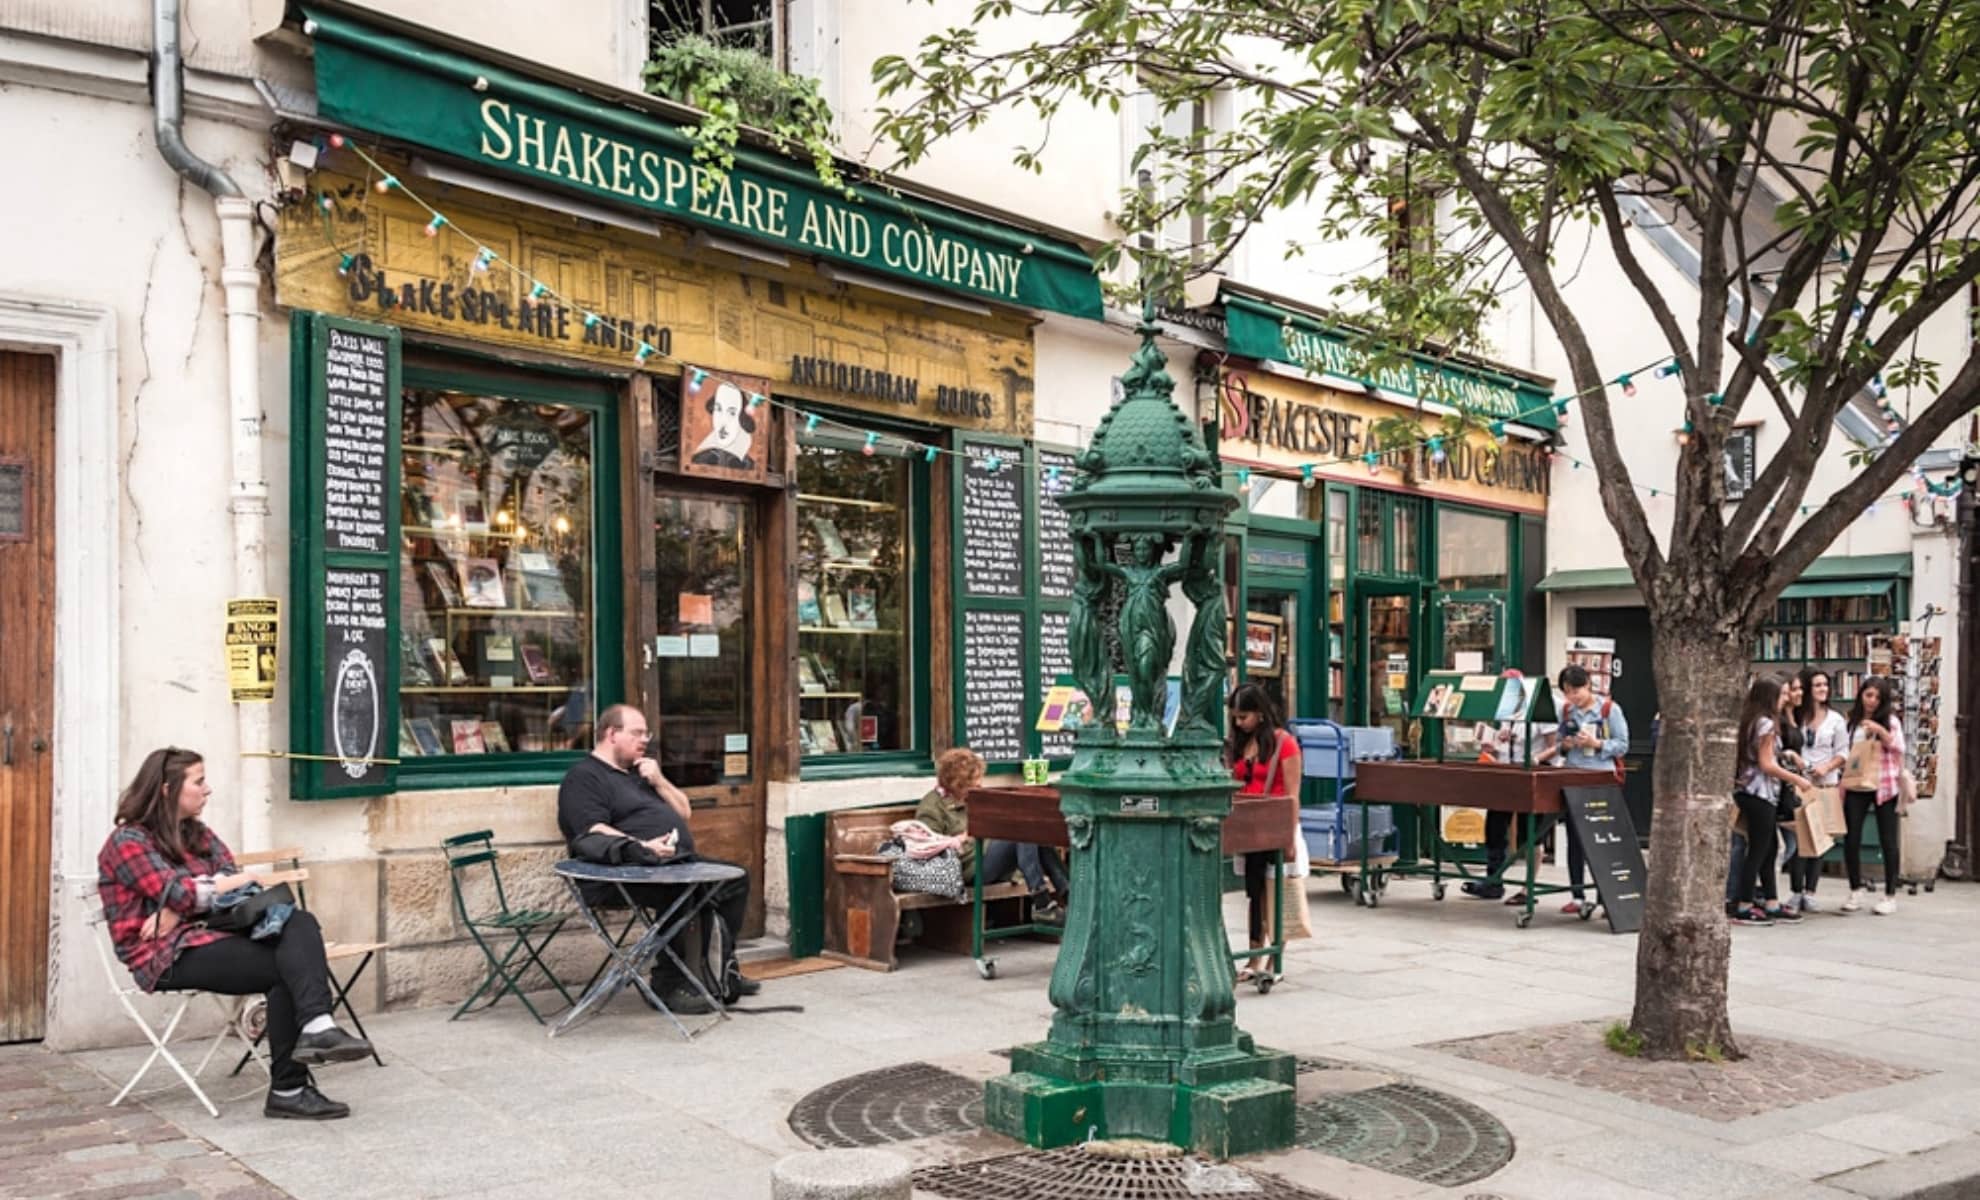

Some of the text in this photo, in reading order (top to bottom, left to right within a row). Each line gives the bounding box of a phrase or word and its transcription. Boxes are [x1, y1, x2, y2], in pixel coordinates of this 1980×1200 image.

[480, 97, 1022, 299] SHAKESPEARE AND COMPANY
[584, 314, 634, 353] AND
[791, 355, 991, 419] ANTIQUARIAN BOOKS
